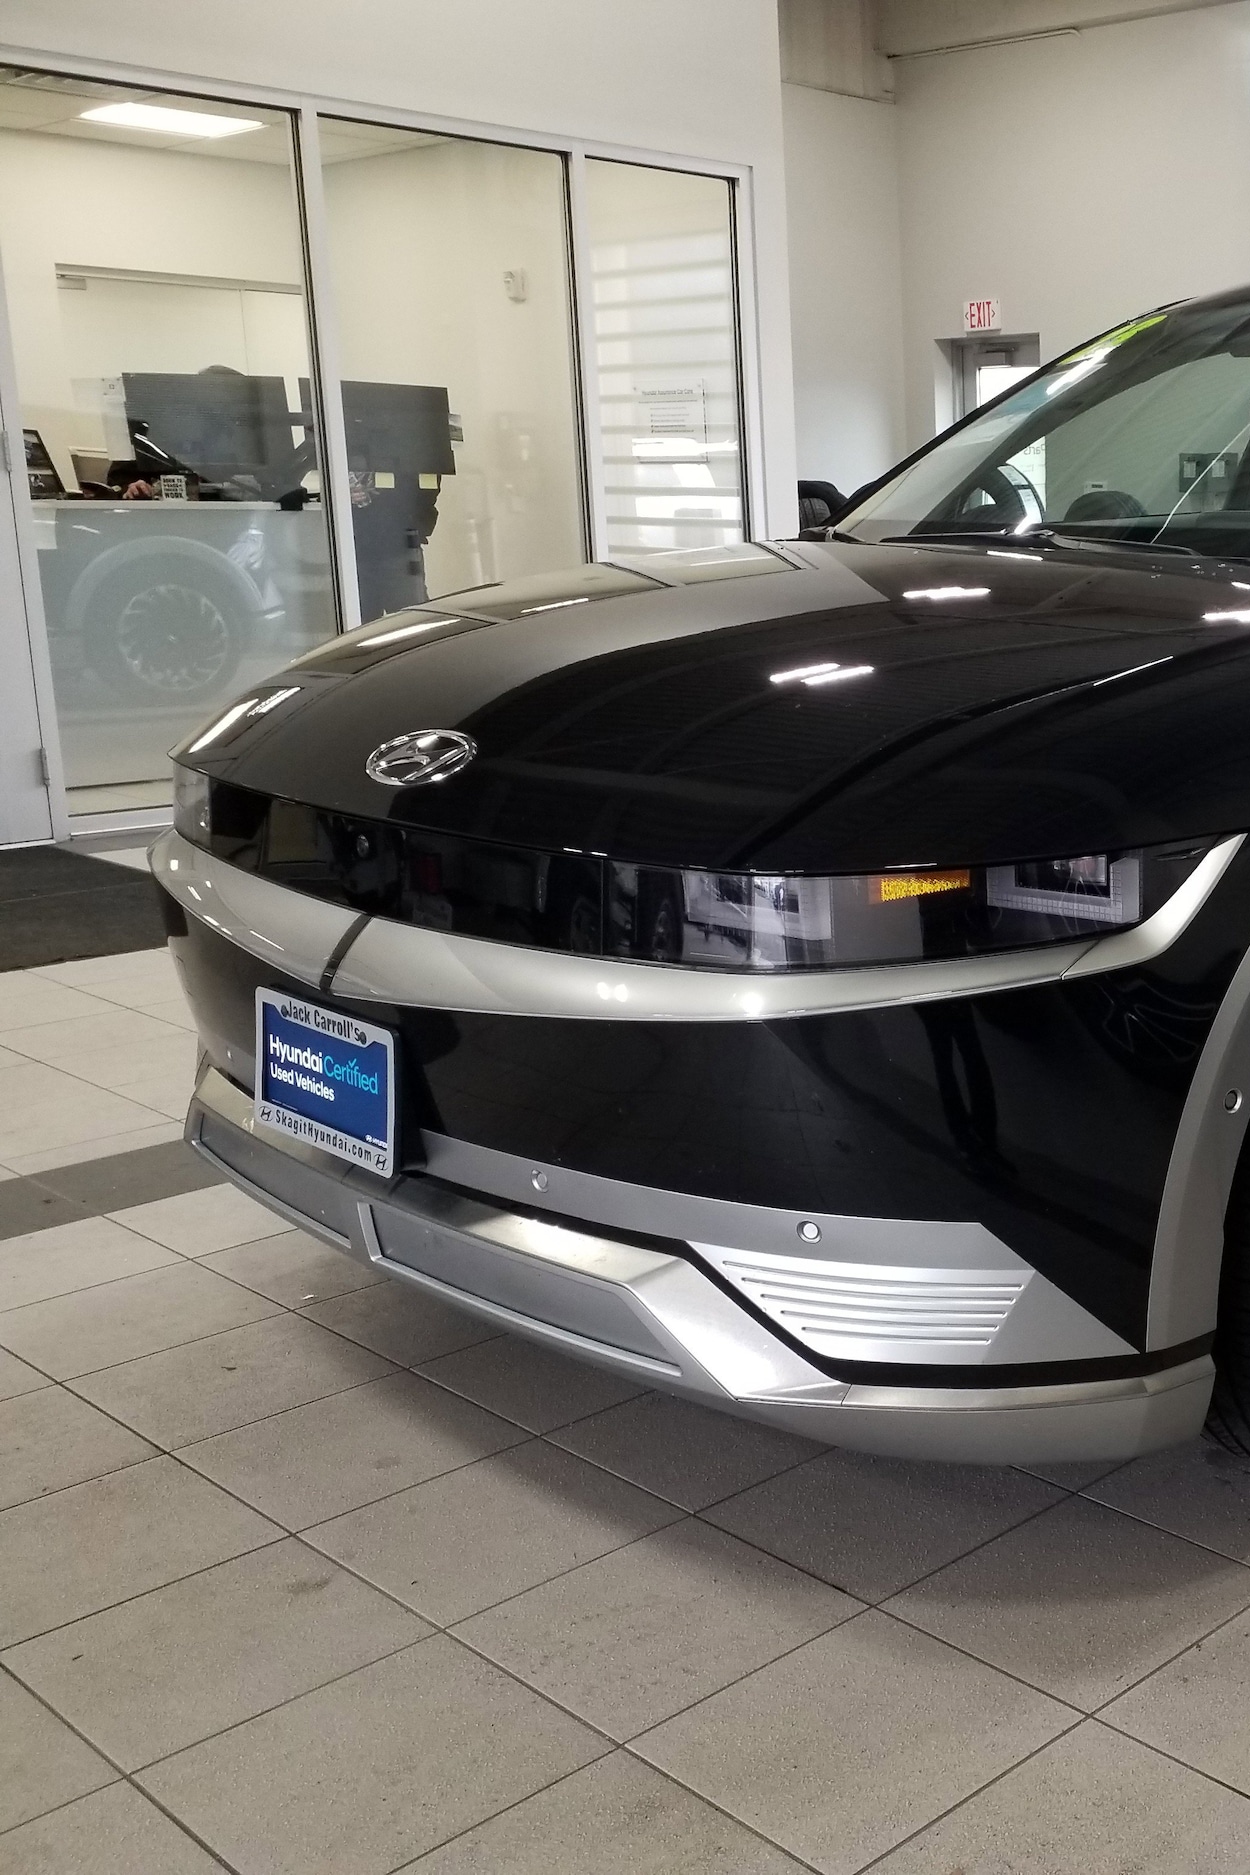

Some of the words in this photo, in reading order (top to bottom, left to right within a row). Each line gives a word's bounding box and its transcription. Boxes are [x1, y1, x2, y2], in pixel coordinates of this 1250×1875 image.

[969, 301, 991, 328] EXIT
[286, 1001, 311, 1024] Jack
[313, 1010, 361, 1040] Carroll's
[269, 1033, 323, 1074] Hyundai
[323, 1055, 379, 1095] Certified
[270, 1062, 294, 1087] Used
[294, 1071, 335, 1101] Vehicles
[275, 1109, 372, 1162] SkagitHyundai.com
